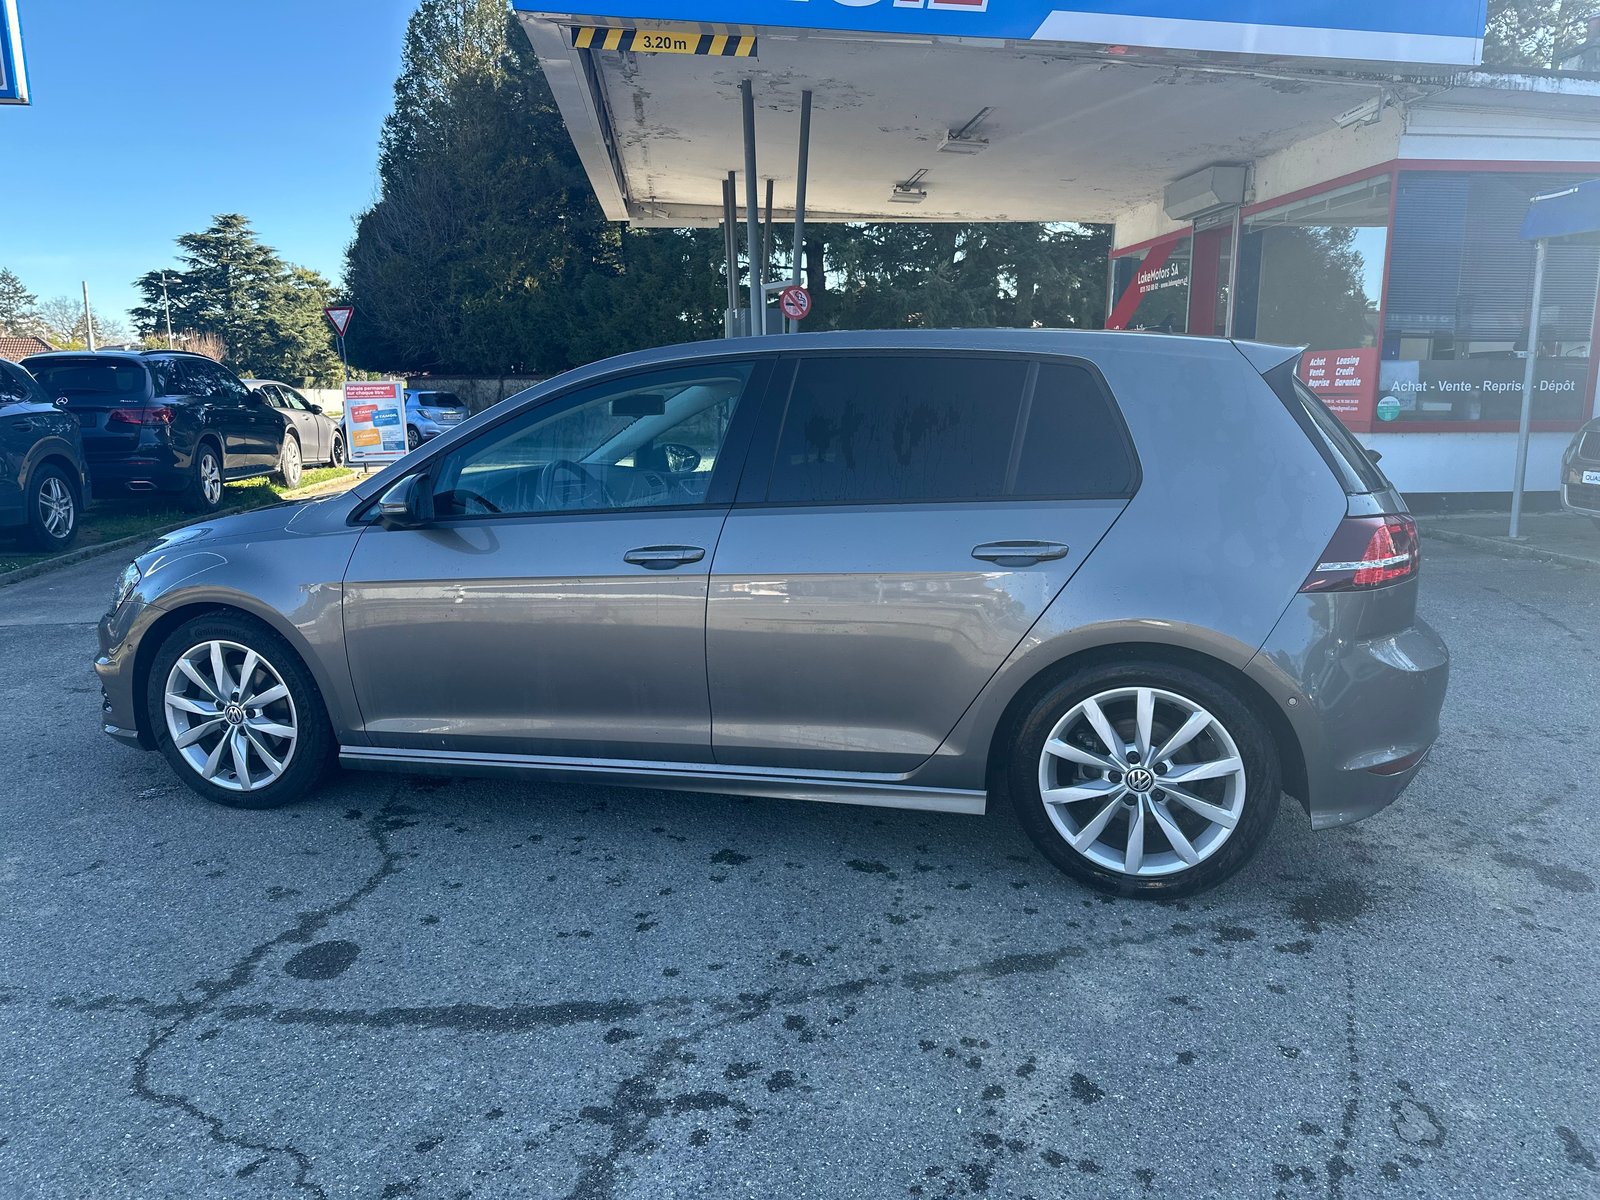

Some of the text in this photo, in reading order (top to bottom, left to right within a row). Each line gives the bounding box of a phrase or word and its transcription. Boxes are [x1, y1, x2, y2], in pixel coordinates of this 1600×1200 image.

[643, 35, 687, 50] 3.20 m
[1138, 262, 1179, 284] LakeMotors SA
[1310, 358, 1326, 366] Achat
[1336, 356, 1360, 366] Leasing
[1309, 368, 1326, 376] Vente
[1308, 378, 1330, 388] Reprise
[1334, 377, 1361, 387] Garantie
[1391, 380, 1428, 392] Achat
[1438, 380, 1472, 392] Vente
[1540, 379, 1575, 394] Dépôt
